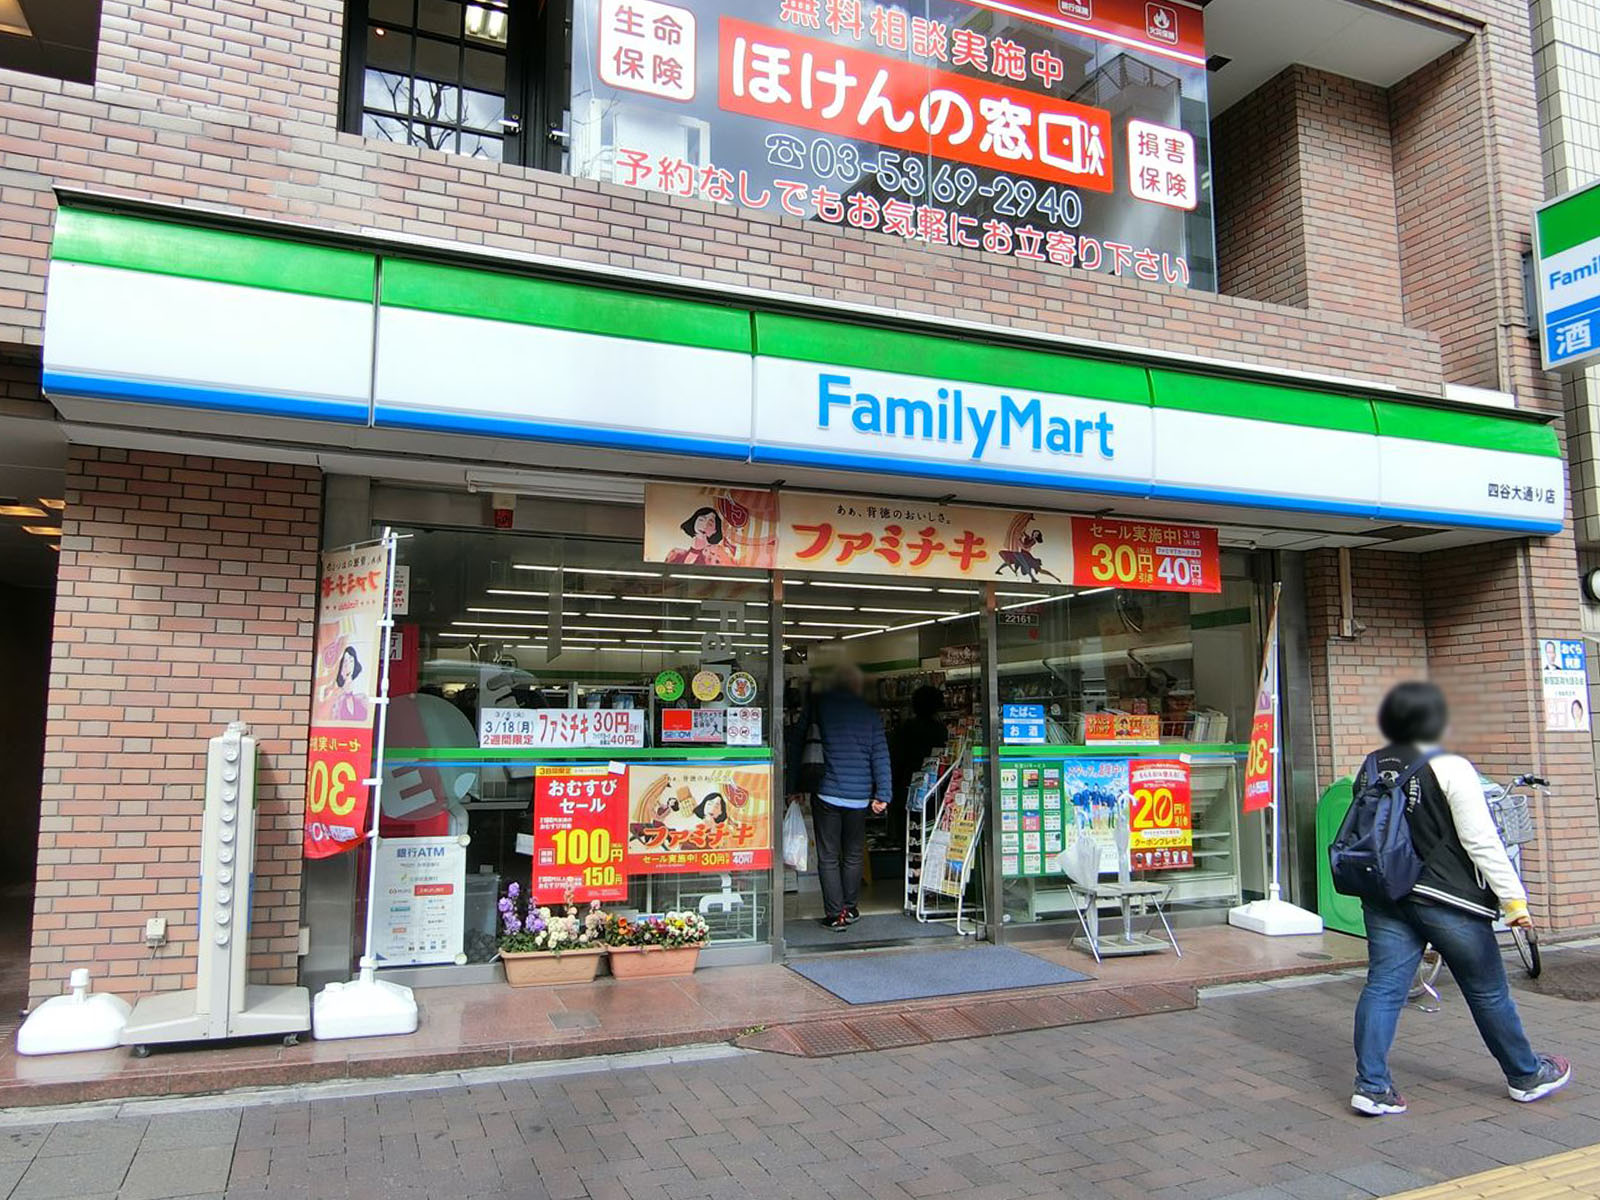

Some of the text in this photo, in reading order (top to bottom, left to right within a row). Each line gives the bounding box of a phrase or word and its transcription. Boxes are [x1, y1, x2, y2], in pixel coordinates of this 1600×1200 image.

[614, 5, 683, 45] 生命
[781, 0, 1064, 88] 無料相談実施中
[613, 46, 683, 90] 保険
[732, 36, 1089, 174] ほけんの窓口
[1138, 130, 1185, 163] 損害
[810, 137, 1082, 228] 03-5369-2940
[1139, 167, 1187, 200] 保険
[615, 148, 1190, 284] 予約なしでもお気軽にお立寄り下さい
[1549, 255, 1600, 290] Fami
[1555, 318, 1591, 355] 酒
[817, 373, 1114, 459] FamilyMart
[1487, 482, 1556, 504] 四谷大通り店
[791, 522, 988, 571] ファミチキ
[1005, 614, 1031, 624] 22161
[485, 721, 534, 733] 3/18(月)
[539, 712, 589, 743] ファミチキ
[1009, 706, 1038, 718] たばこ
[483, 734, 534, 746] 2週間限定
[664, 731, 691, 739] SECOM
[548, 779, 617, 797] おむすび
[559, 798, 606, 814] セール
[1133, 788, 1173, 828] 20
[643, 823, 755, 847] ファミチキ
[396, 847, 445, 858] 銀行ATM
